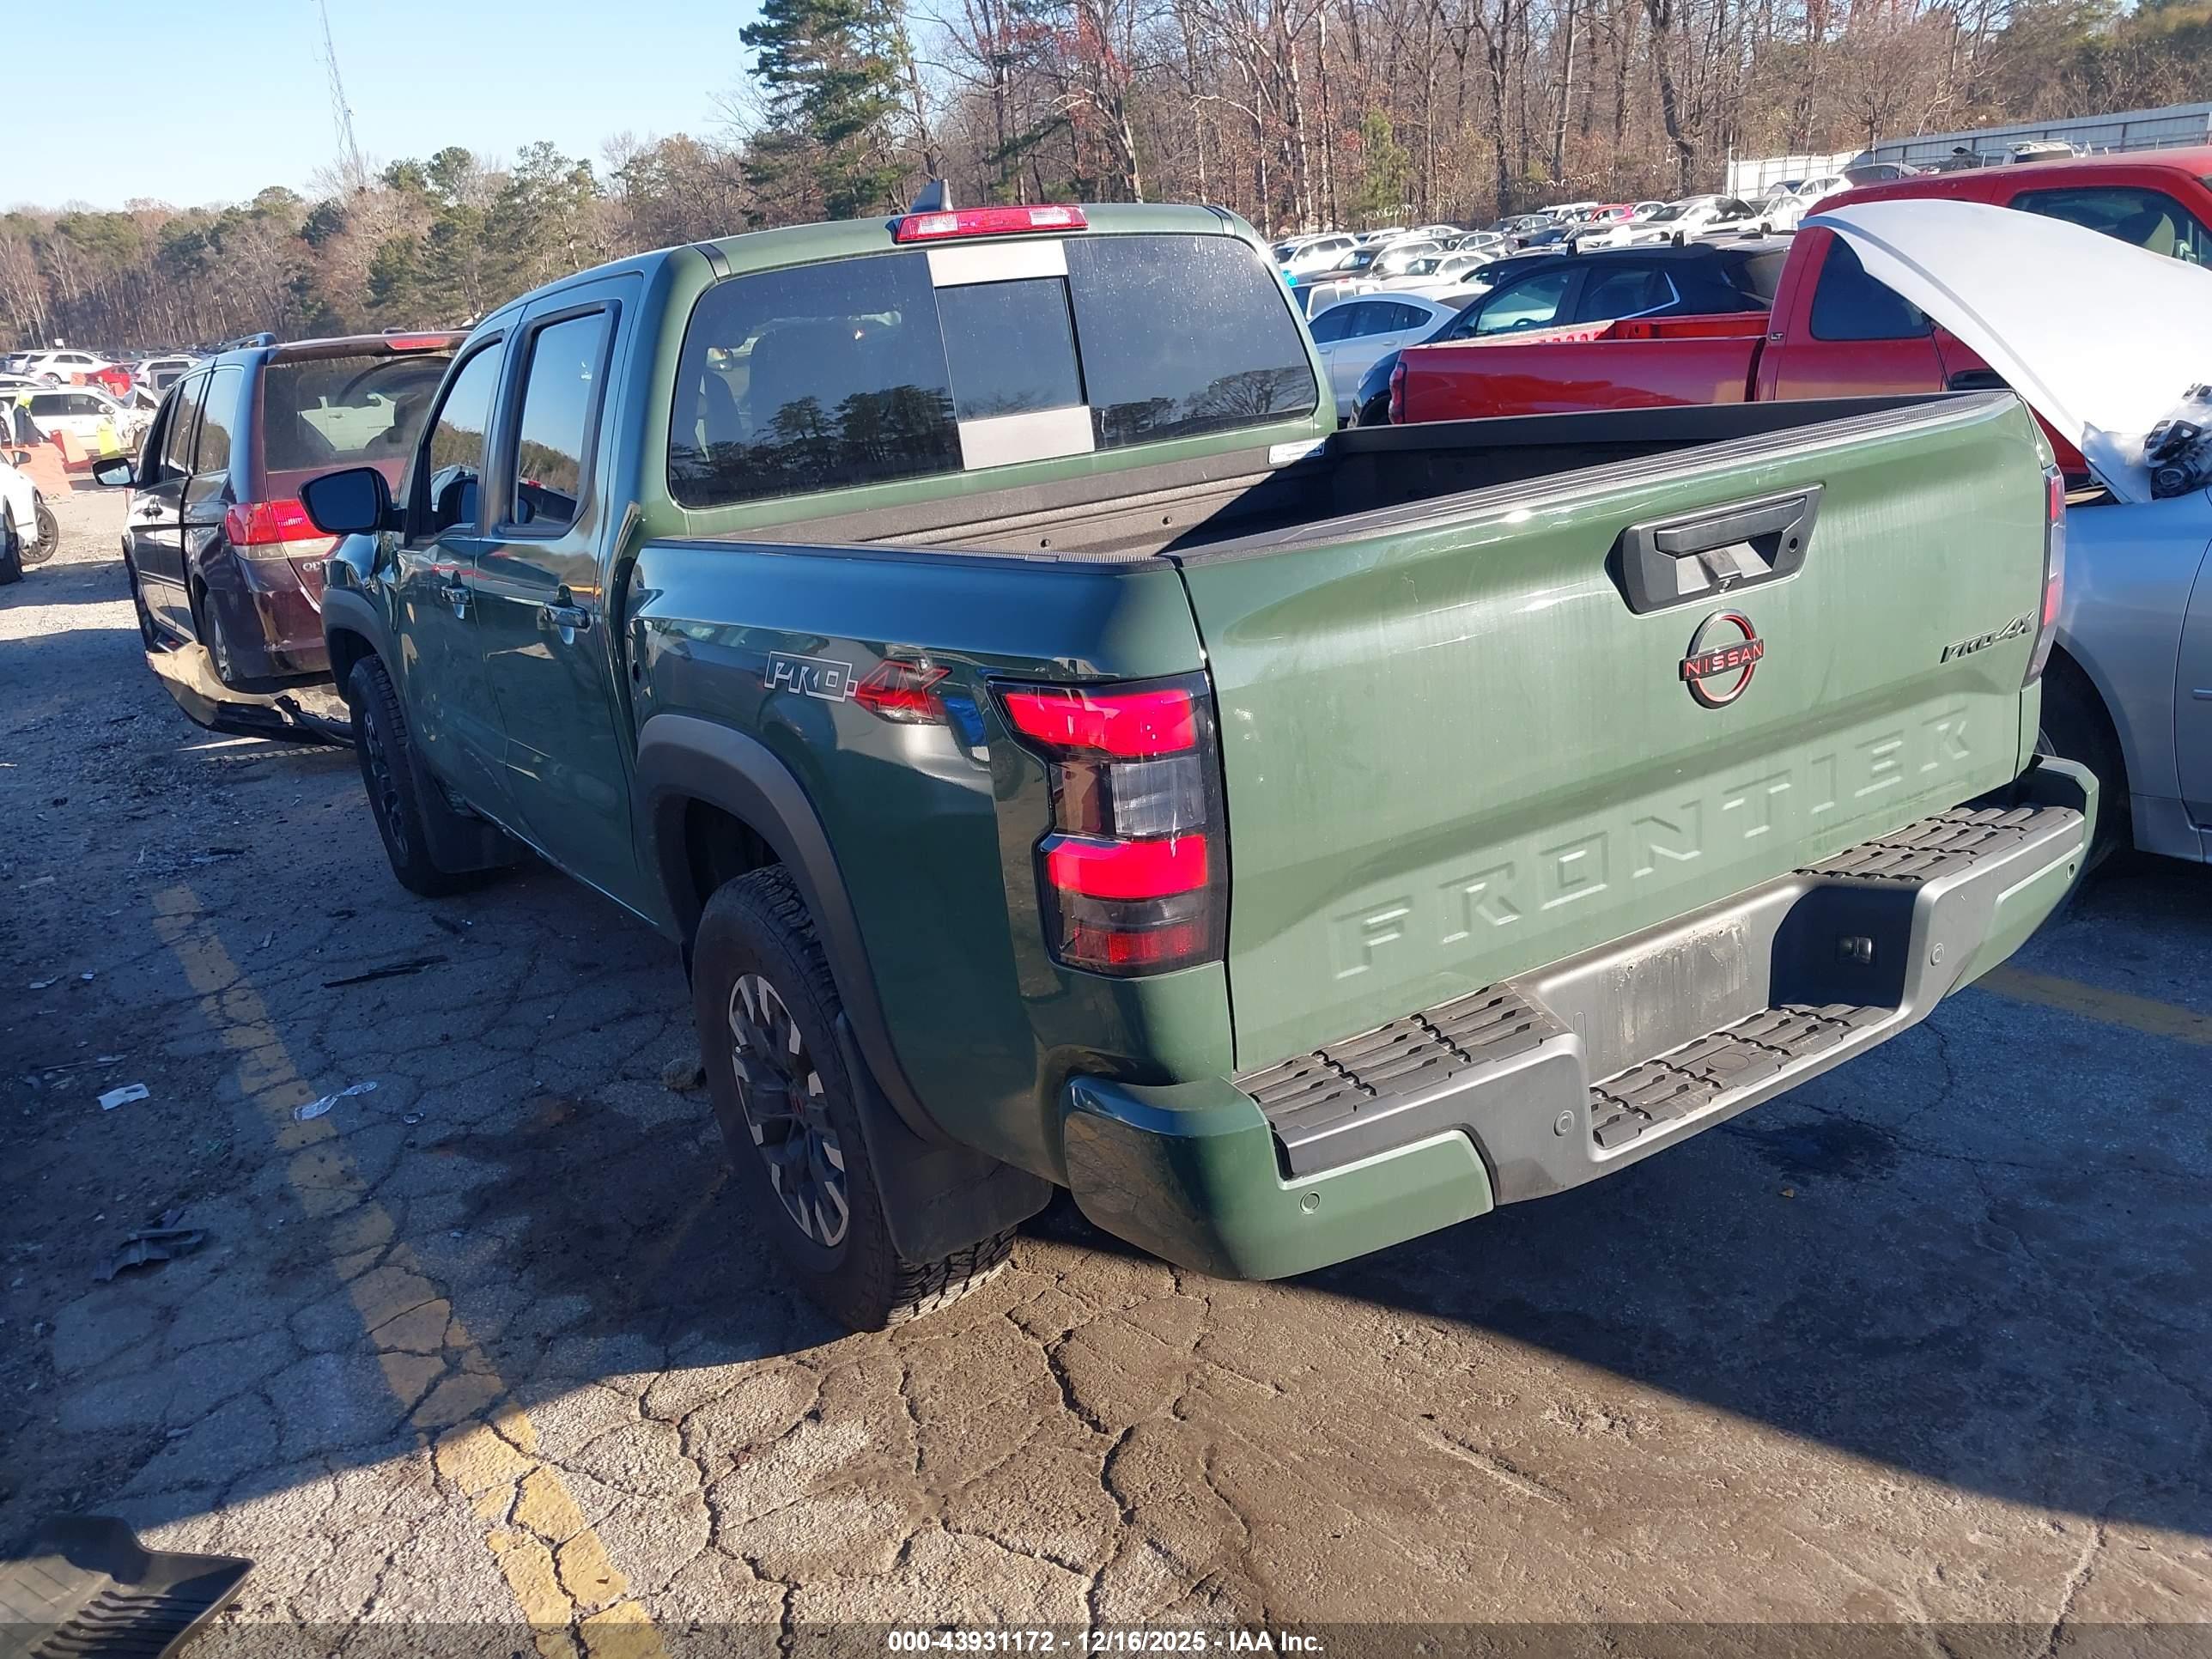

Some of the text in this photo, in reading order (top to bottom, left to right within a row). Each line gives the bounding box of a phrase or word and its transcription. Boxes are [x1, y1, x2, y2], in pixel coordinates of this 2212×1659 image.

[764, 650, 953, 720] PRO-4X
[1684, 641, 1763, 678] NISSAN
[1331, 704, 1972, 981] FRONTIER
